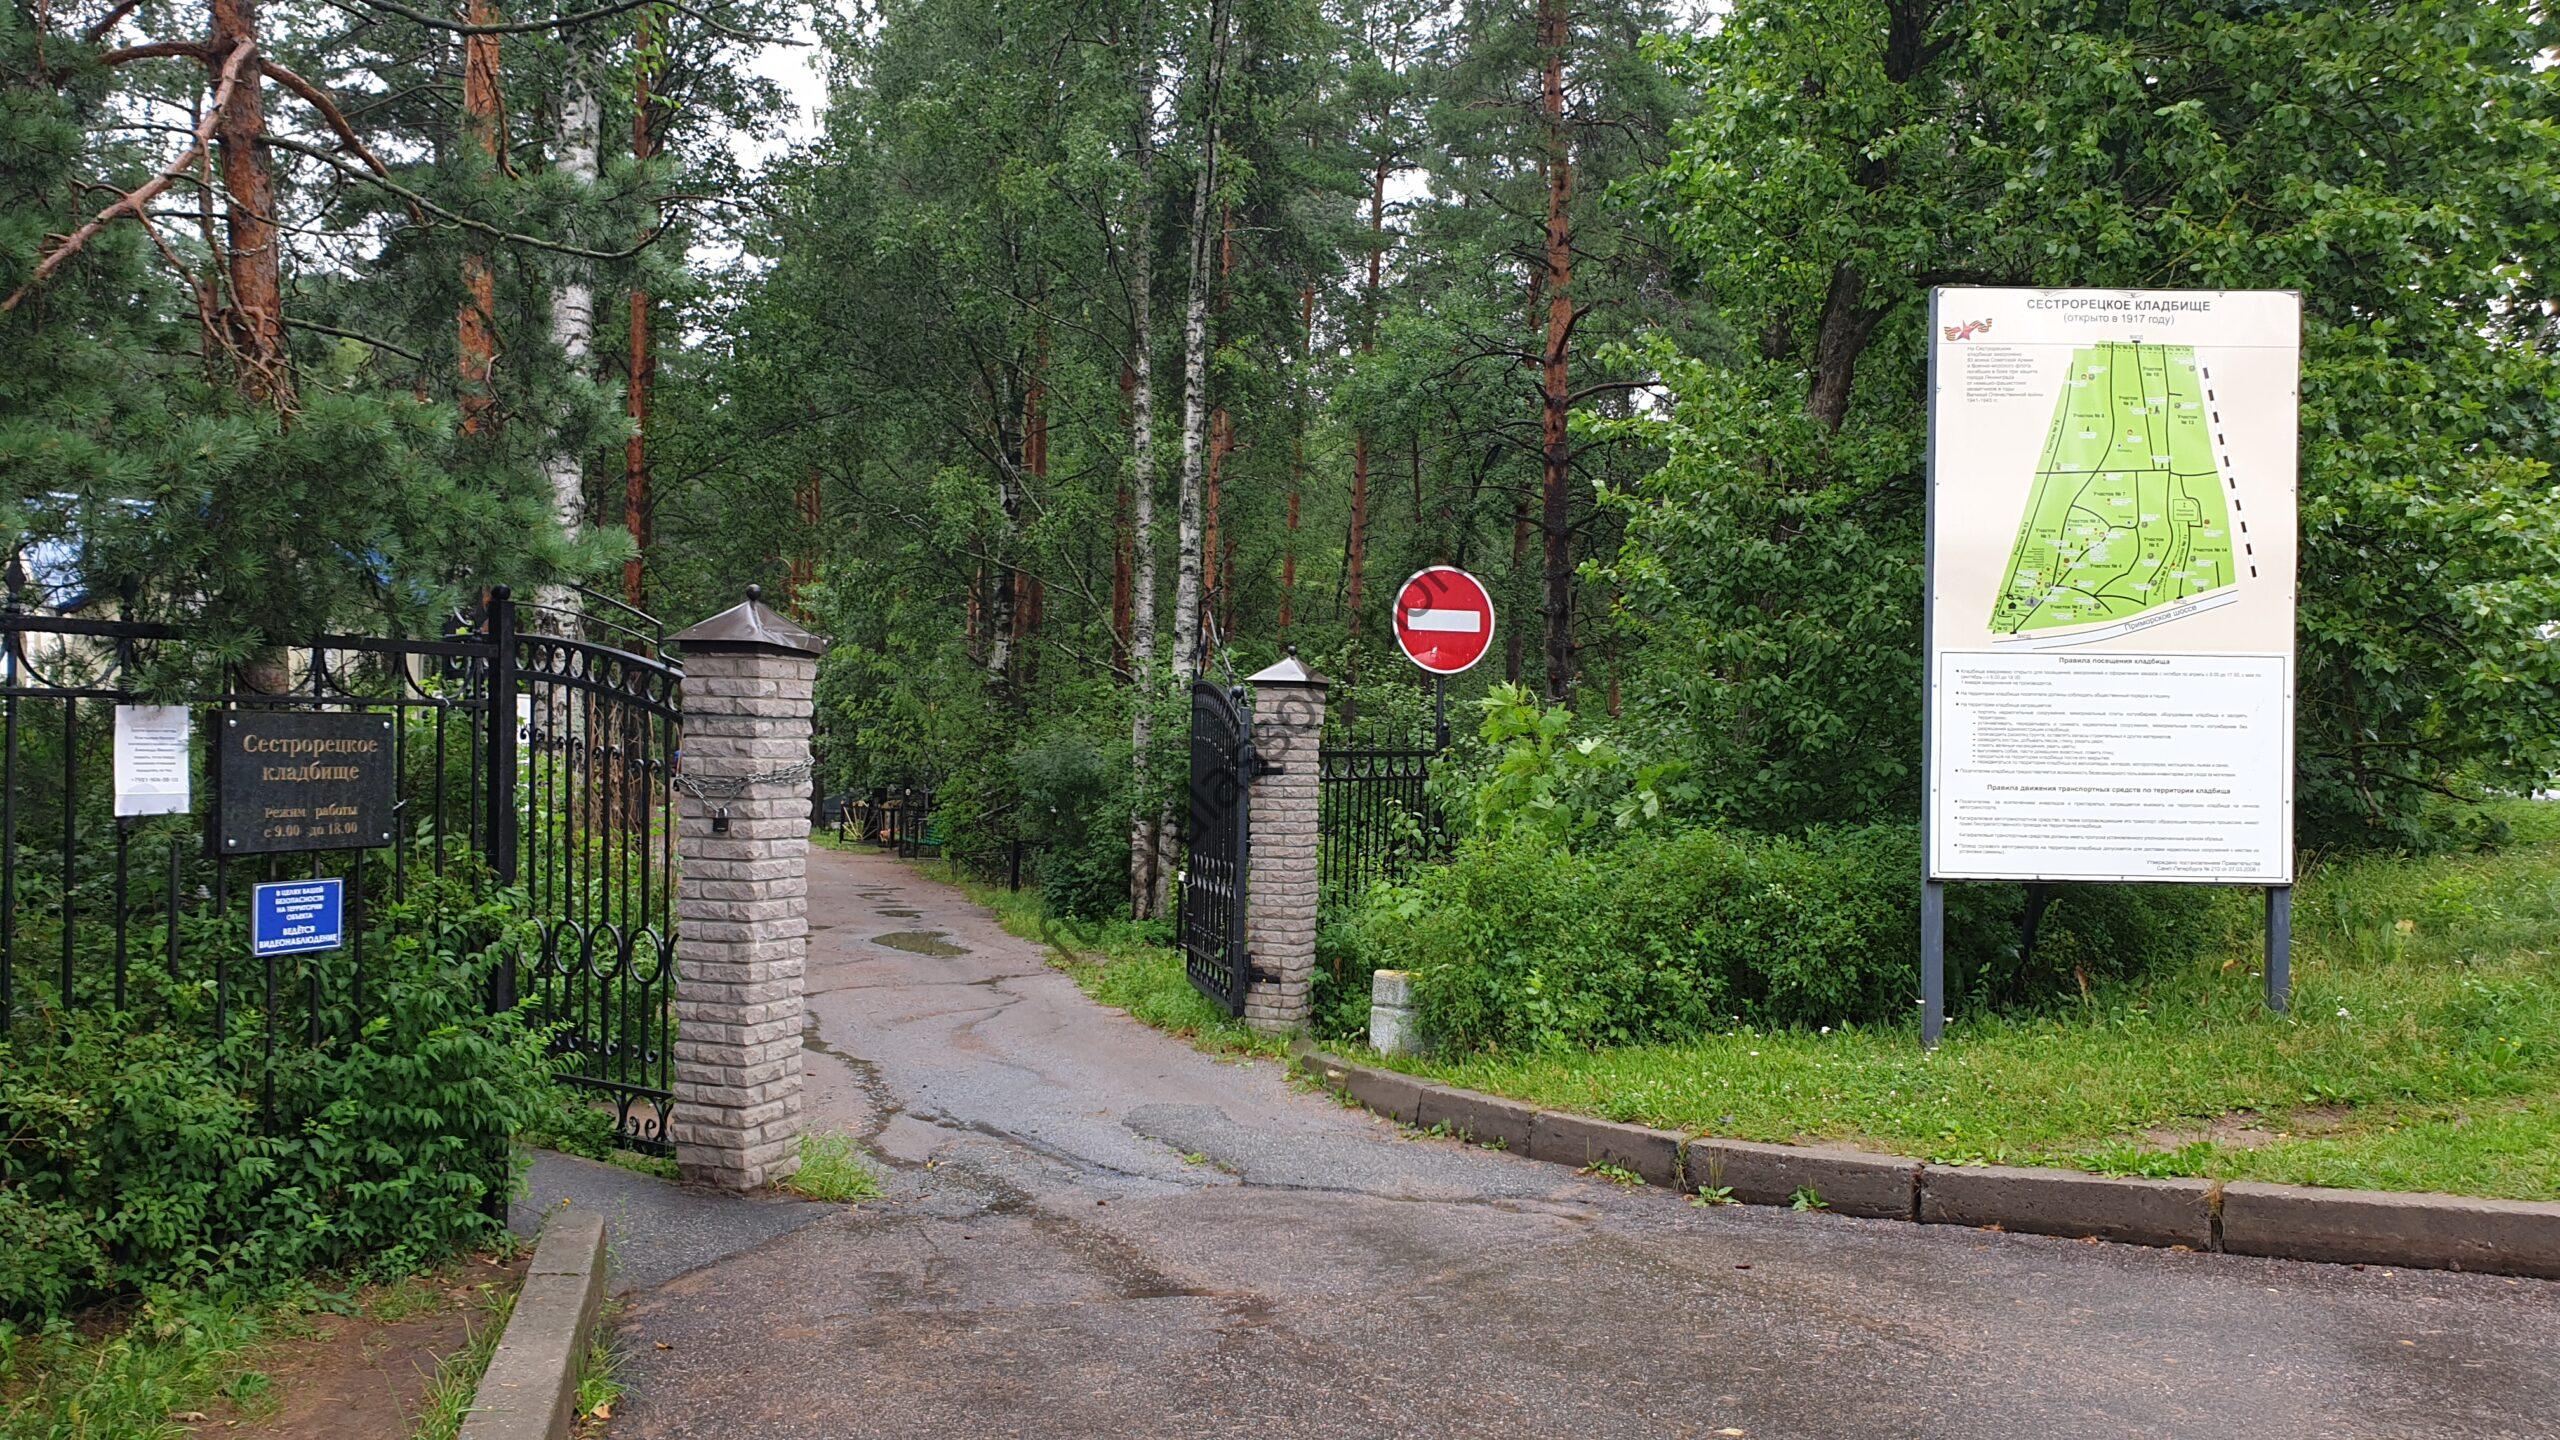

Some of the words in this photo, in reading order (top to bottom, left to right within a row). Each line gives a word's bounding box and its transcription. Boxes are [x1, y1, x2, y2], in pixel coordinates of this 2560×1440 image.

[2027, 299, 2131, 310] СЕСТРОРЕЦКОЕ
[2135, 300, 2210, 312] КЛАДБИЩЕ
[2063, 313, 2109, 323] (открыто
[2121, 314, 2145, 323] 1917
[2148, 315, 2175, 326] году)
[2124, 613, 2172, 631] Приморское
[2172, 605, 2197, 617] шоссе
[243, 734, 378, 757] Сестрорецкое
[263, 761, 360, 782] кладбище
[2196, 787, 2230, 795] кладбища
[315, 804, 358, 819] работы
[263, 829, 271, 838] с
[274, 825, 300, 837] 9.00
[309, 826, 324, 837] до
[328, 822, 358, 835] 18.00
[258, 933, 337, 949] ВИДЕОНАБЛЮДЕНИЕ
